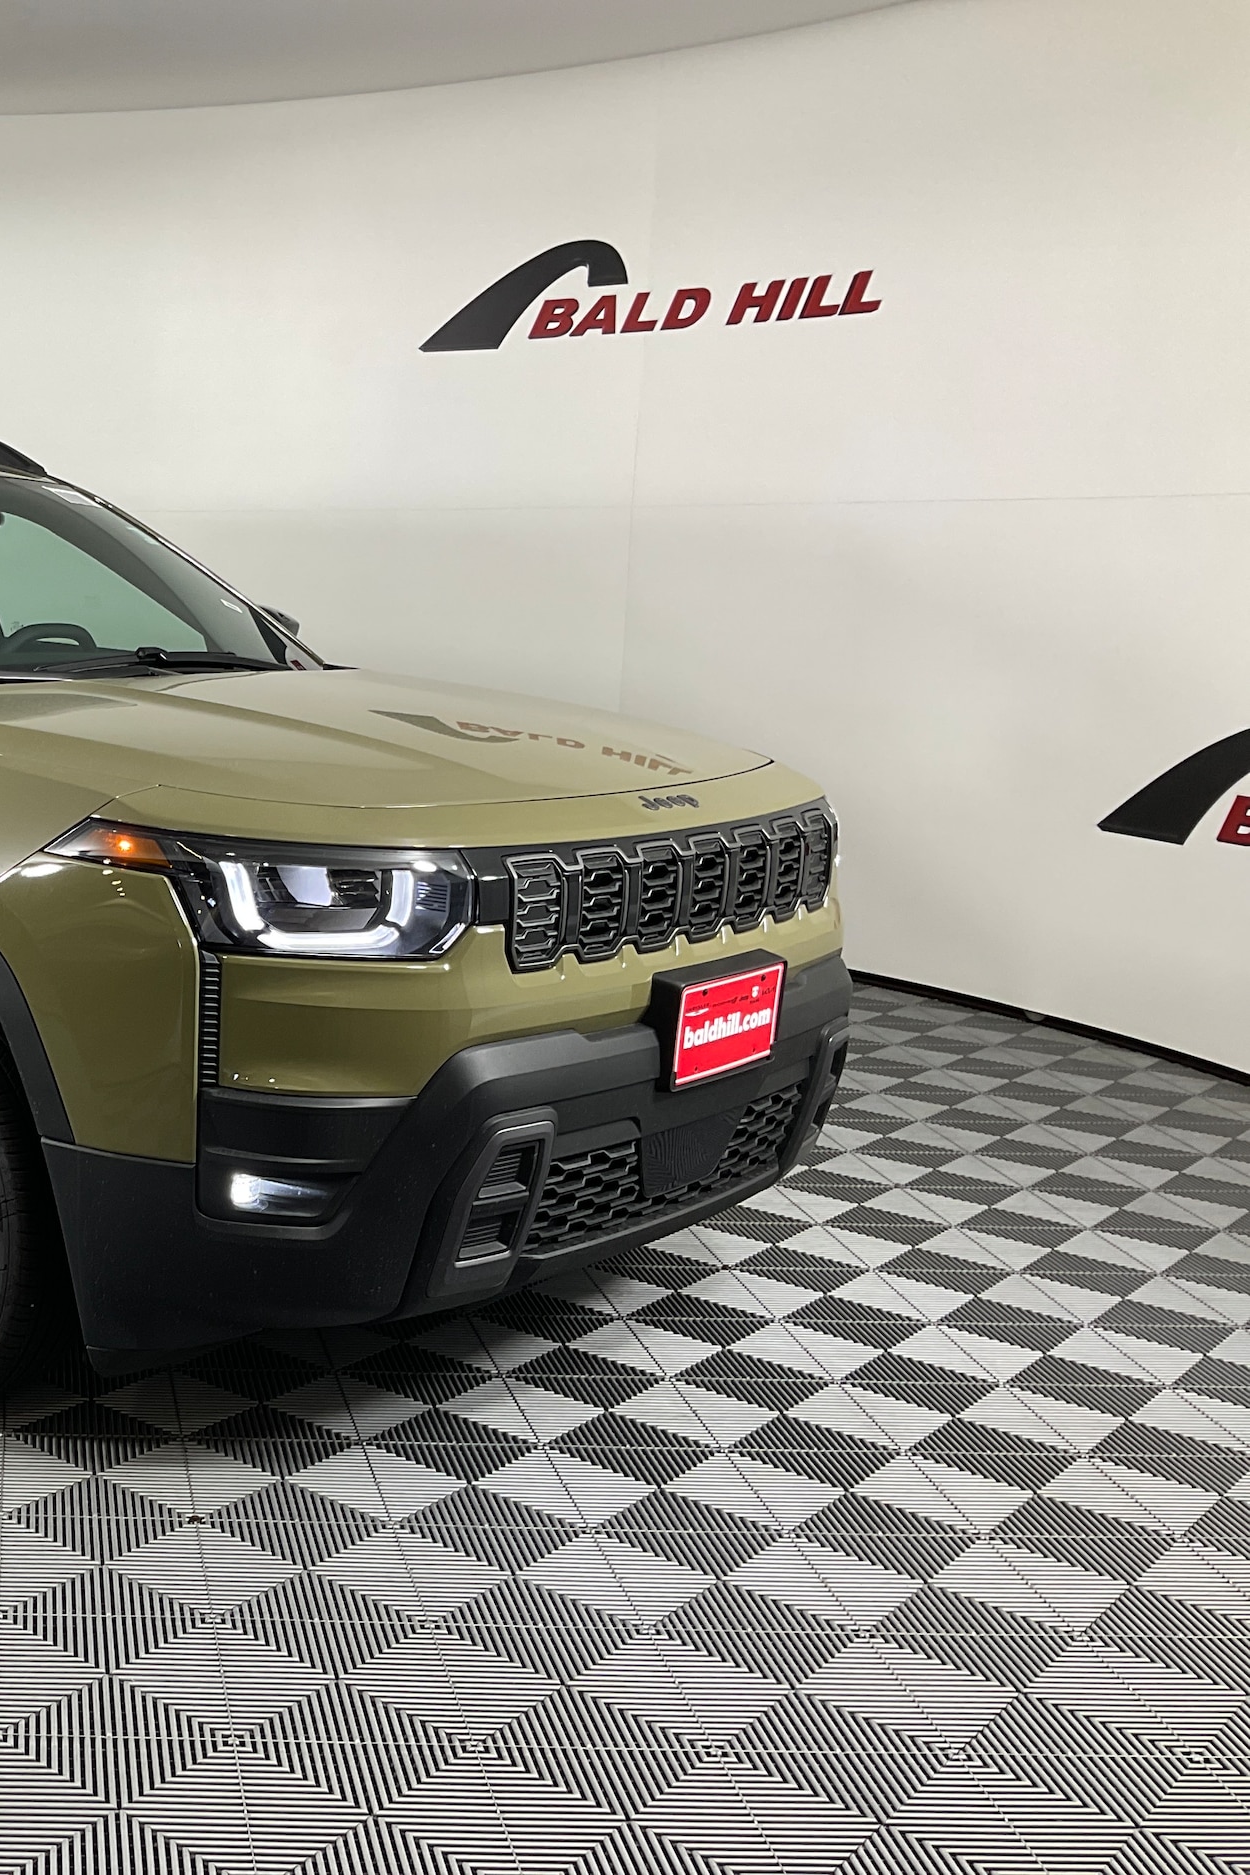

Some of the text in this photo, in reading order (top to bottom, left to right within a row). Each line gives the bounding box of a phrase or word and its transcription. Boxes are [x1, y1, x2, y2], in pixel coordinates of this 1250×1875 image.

[528, 269, 882, 340] BALD HILL
[637, 794, 700, 811] Jeep
[682, 1007, 772, 1050] baldhill.com
